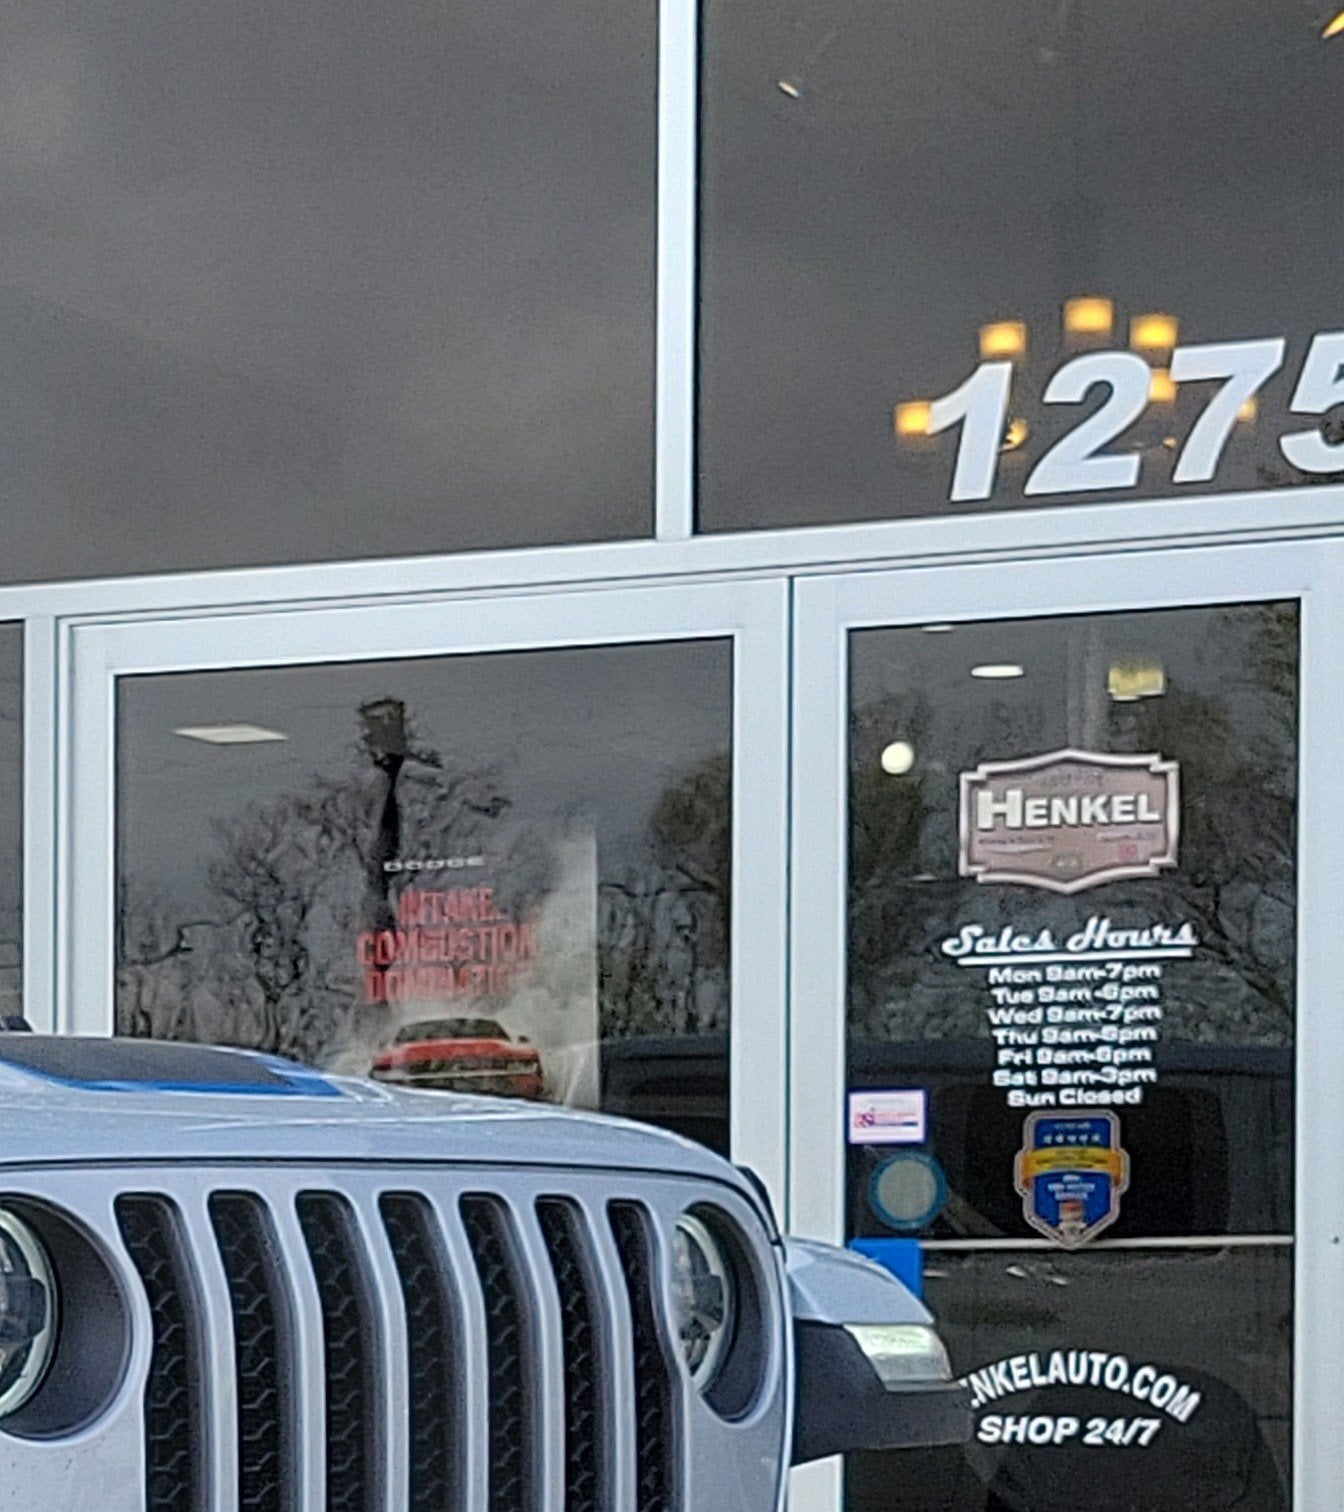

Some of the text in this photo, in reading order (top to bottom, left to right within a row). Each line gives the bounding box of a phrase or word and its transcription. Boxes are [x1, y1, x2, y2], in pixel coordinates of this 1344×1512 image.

[927, 331, 1344, 501] 1275
[977, 789, 1160, 830] HENKEL
[941, 915, 1198, 956] Sales Hours
[988, 967, 1042, 985] Mon
[991, 987, 1035, 1005] Tue
[987, 1007, 1043, 1025] Wed
[992, 1029, 1039, 1045] Thu
[998, 1049, 1033, 1065] Fri
[993, 1069, 1038, 1086] Sat
[1007, 1086, 1143, 1107] Sun Closed
[959, 1350, 1202, 1423] NKELAUTO.COM
[977, 1414, 1162, 1446] SHOP 24/7
